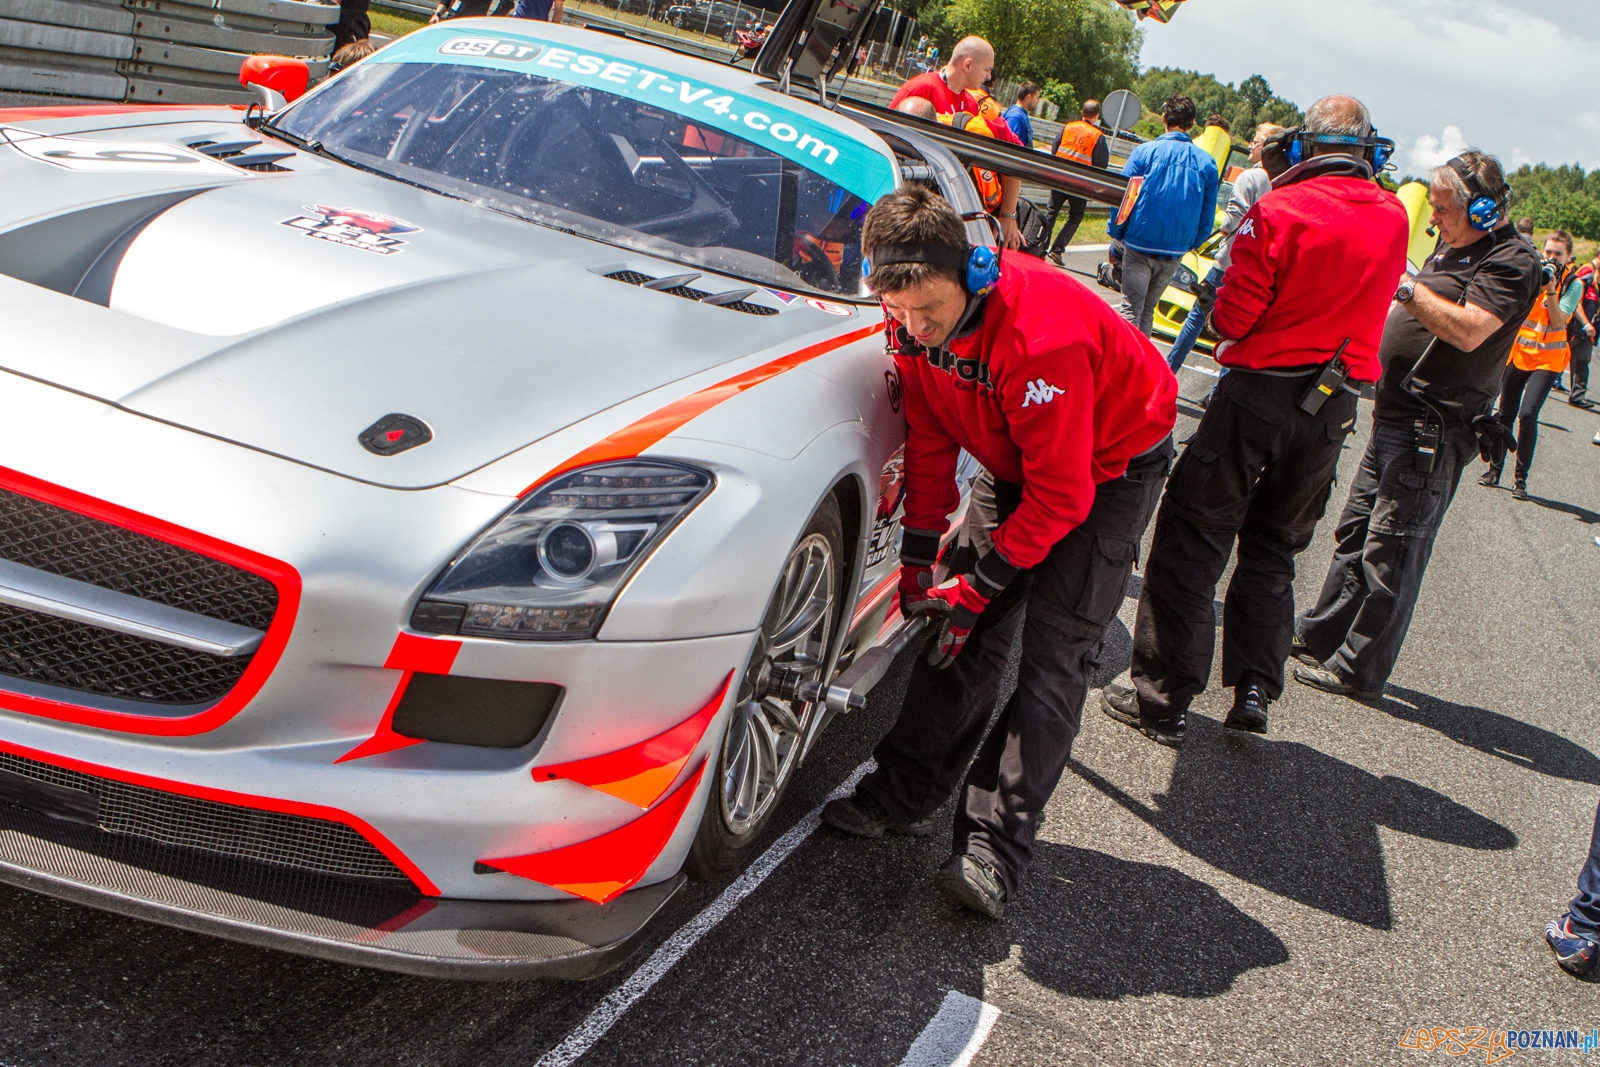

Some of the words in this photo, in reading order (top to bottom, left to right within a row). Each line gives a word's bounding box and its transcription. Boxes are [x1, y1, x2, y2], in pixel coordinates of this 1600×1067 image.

[537, 47, 840, 166] ESET-V4.com
[1073, 134, 1085, 145] 16
[287, 216, 397, 247] LEV
